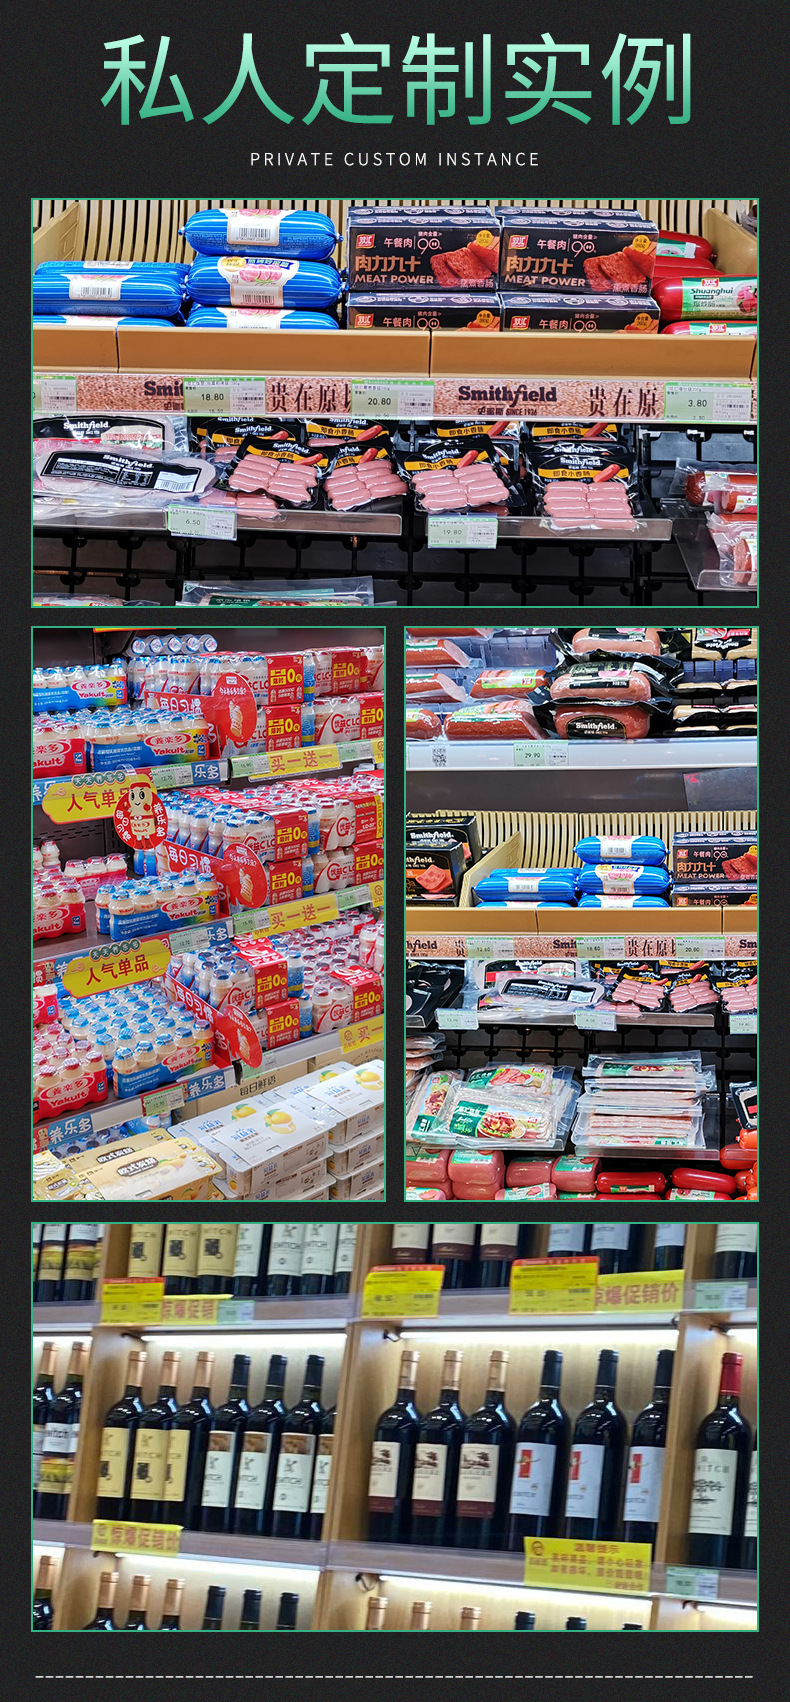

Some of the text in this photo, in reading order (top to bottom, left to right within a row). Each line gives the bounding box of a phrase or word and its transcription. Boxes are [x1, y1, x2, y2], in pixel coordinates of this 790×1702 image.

[383, 237, 413, 248] 午餐肉
[537, 240, 567, 250] 午餐肉
[354, 255, 421, 273] 肉力九十
[505, 256, 574, 275] 肉力九十
[354, 274, 434, 284] MEAT POWER
[504, 275, 586, 287] MEAT POWER
[689, 286, 734, 296] Shuanghui
[383, 317, 412, 328] 午餐肉
[539, 319, 569, 330] 午餐肉
[201, 393, 224, 401] 18.80
[367, 397, 391, 406] 20.80
[457, 384, 558, 408] Smithfield
[688, 399, 708, 408] 3.80
[63, 421, 110, 435] Smithfield
[234, 425, 274, 435] Smithfield
[320, 426, 355, 436] 即食小香肠
[448, 426, 484, 436] 即食小香肠
[546, 427, 582, 435] 即食小香肠
[272, 442, 310, 455] Smithfield
[260, 450, 294, 460] 即食小香肠
[422, 449, 460, 462] Smithfield
[102, 454, 154, 470] Smithfield
[419, 458, 454, 469] 即食小香肠
[560, 457, 603, 467] Smithfield
[553, 469, 591, 477] 即食小香肠
[185, 518, 201, 526] 6.50
[78, 691, 106, 699] Yakult
[575, 721, 618, 734] Smithfield
[153, 747, 186, 756] Yakult
[269, 750, 333, 773] 买一送一
[193, 764, 220, 780] 乐多
[410, 832, 450, 841] Smithfield
[168, 909, 200, 921] Yakult
[270, 903, 331, 930] 买一送一
[85, 953, 150, 986] 人气单品
[169, 1058, 195, 1074] Yakult
[188, 1075, 225, 1099] 养乐多
[49, 1089, 89, 1107] Yakult
[48, 1116, 92, 1145] 养乐多
